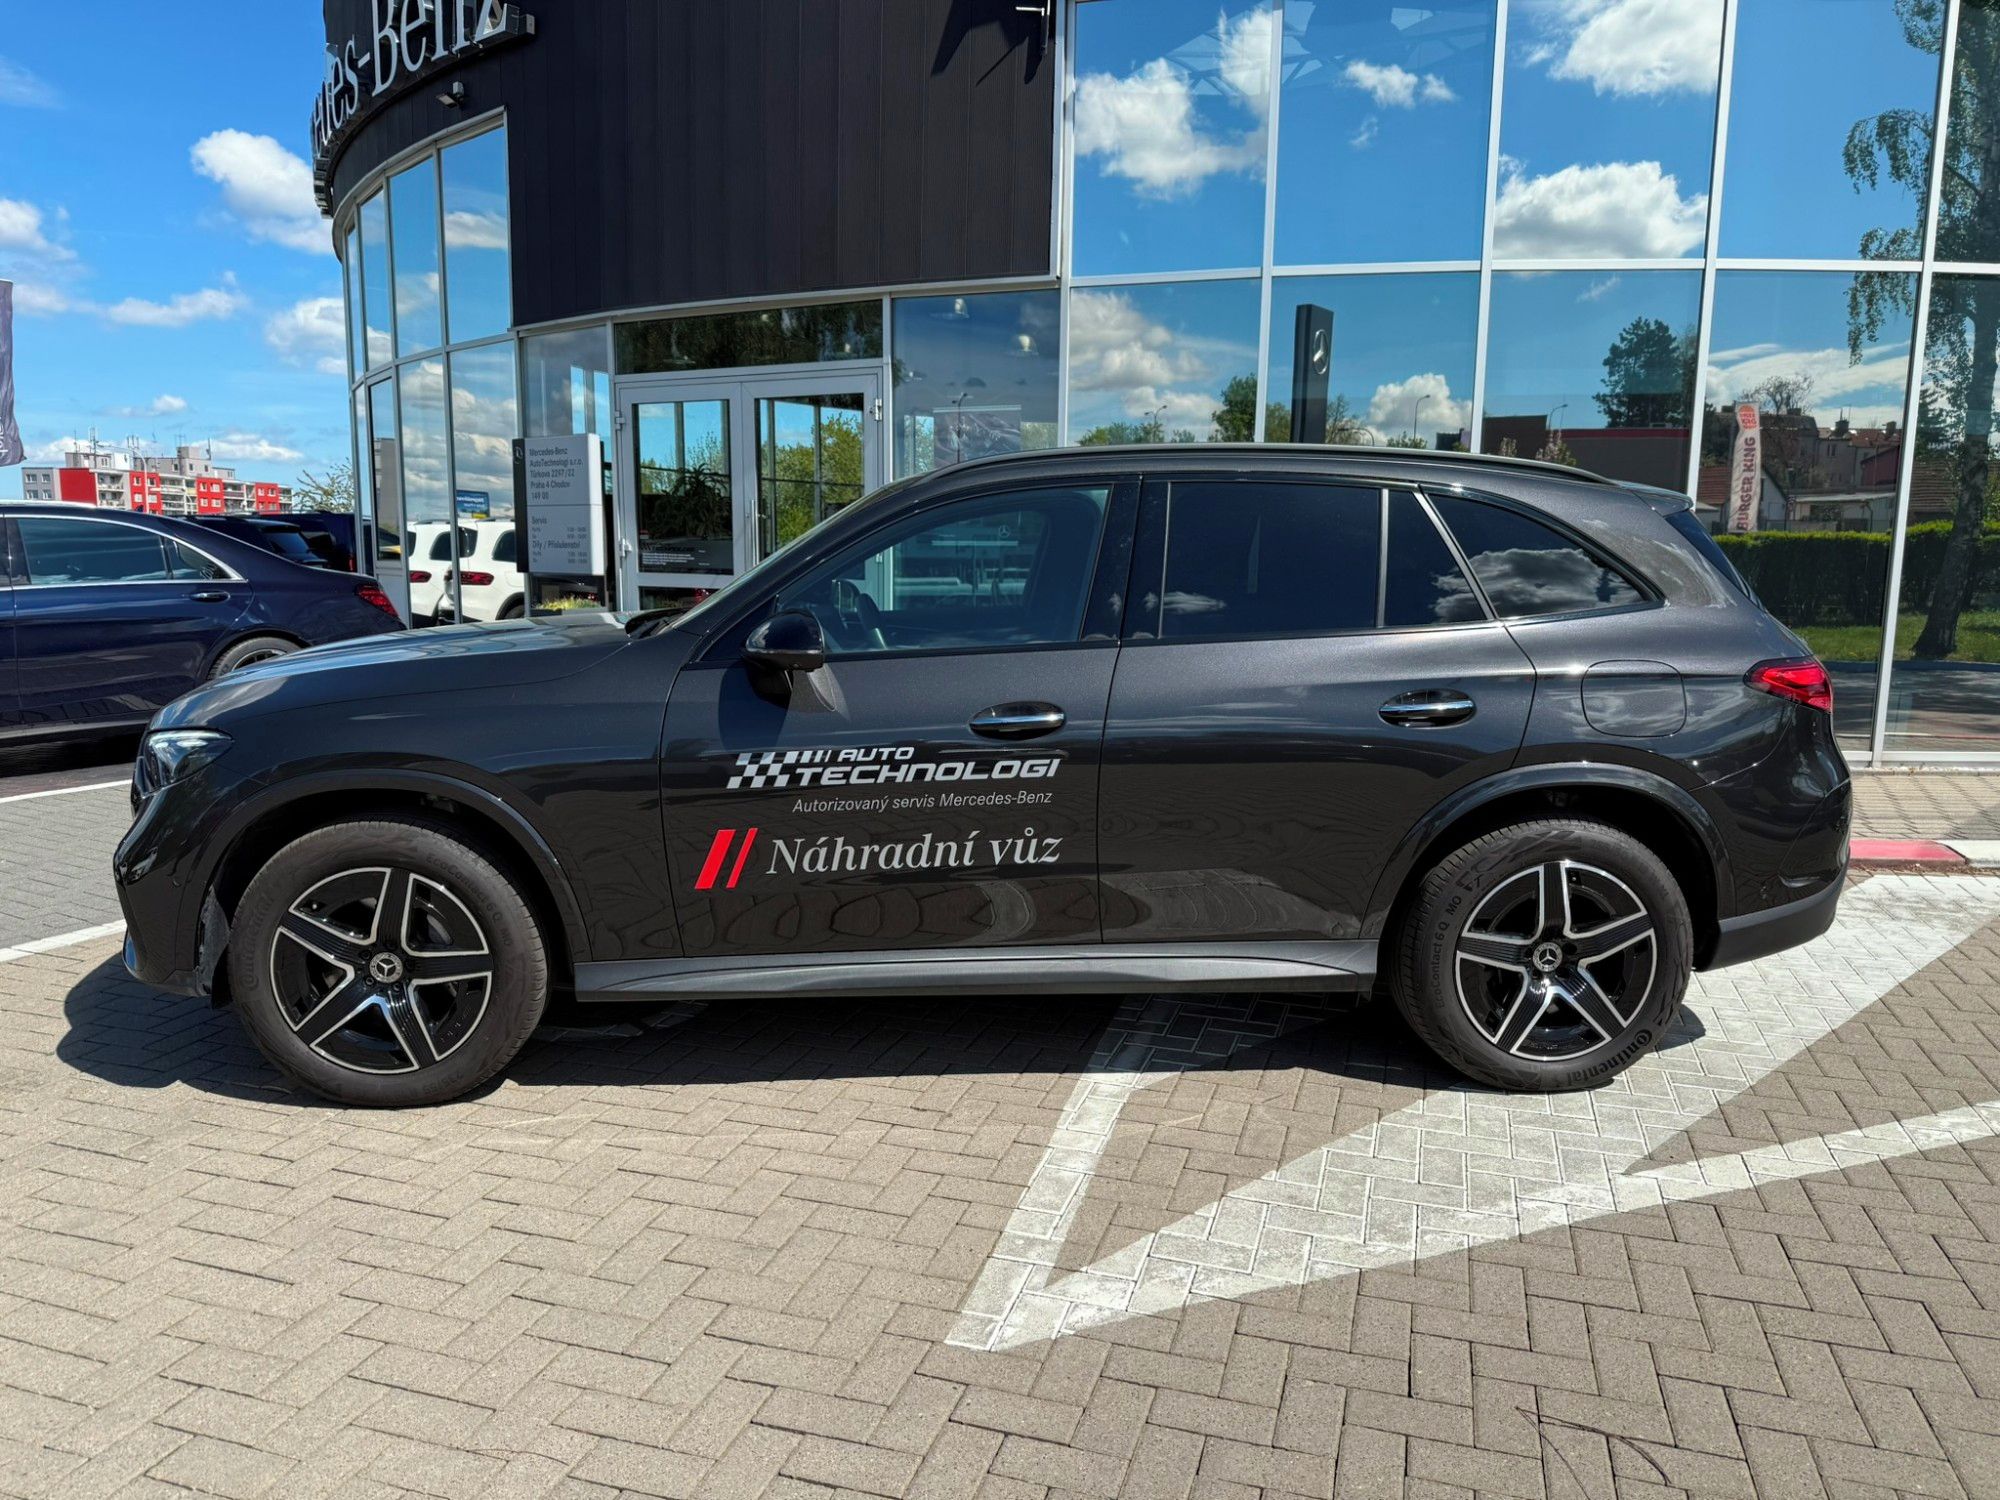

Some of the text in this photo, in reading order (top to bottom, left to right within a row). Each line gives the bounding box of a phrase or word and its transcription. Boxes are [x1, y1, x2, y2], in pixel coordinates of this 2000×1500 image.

[529, 447, 568, 457] Mercedes-Benz
[1743, 437, 1756, 473] KING
[1737, 476, 1754, 531] BURGER
[837, 747, 915, 763] AUTO
[795, 759, 1061, 787] TECHNOLOGI
[792, 790, 1053, 813] Autorizovaný servis Mercedes-Benz
[765, 827, 1064, 875] Náhradní vůz
[1446, 895, 1462, 916] MO
[1434, 932, 1445, 941] 6
[1438, 921, 1450, 931] Q
[1567, 1029, 1653, 1087] Continental
